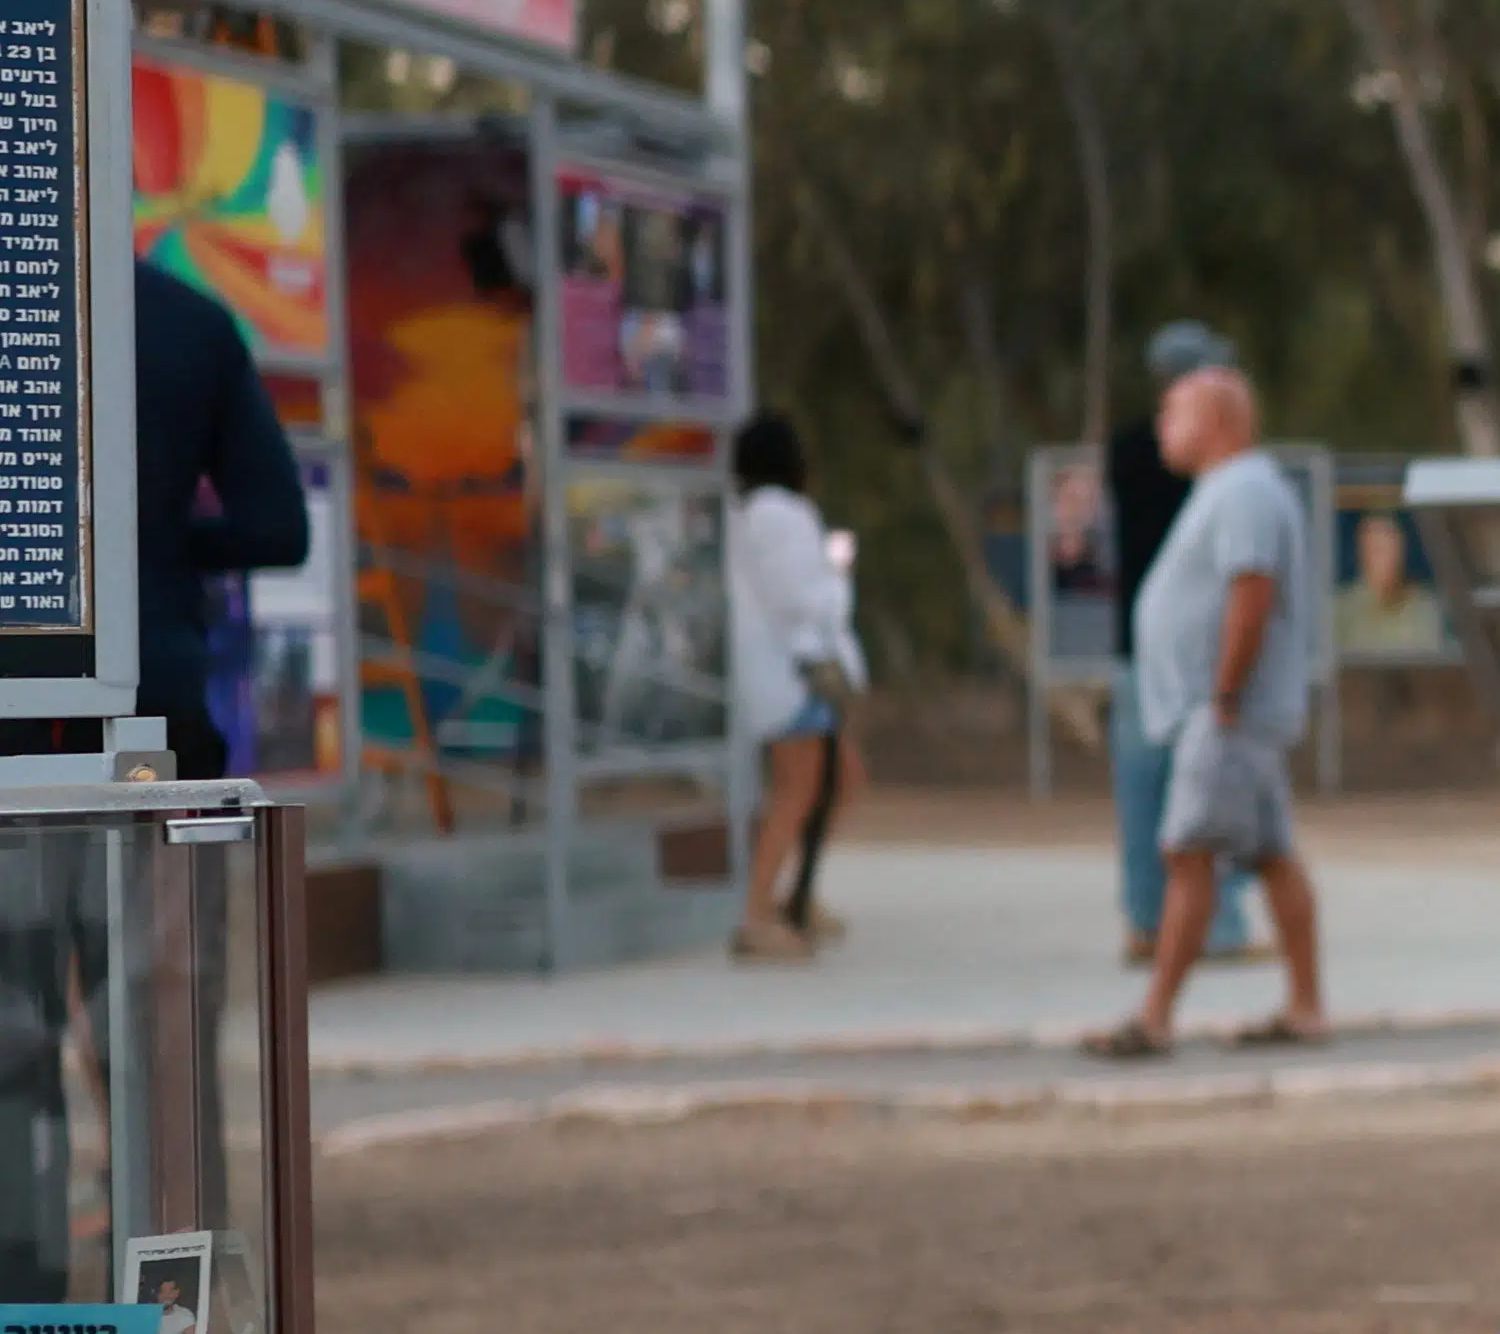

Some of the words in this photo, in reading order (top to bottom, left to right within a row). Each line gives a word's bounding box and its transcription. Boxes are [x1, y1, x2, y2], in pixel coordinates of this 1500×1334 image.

[12, 21, 55, 35] ליאב
[8, 46, 31, 58] 23
[37, 47, 56, 62] בן
[1, 69, 56, 83] ברעים
[21, 91, 56, 107] בעל
[19, 118, 56, 133] חיוך
[14, 140, 57, 155] ליאב
[14, 165, 57, 179] אהוב
[15, 187, 58, 203] ליאב
[19, 213, 58, 227] צנוע
[1, 235, 58, 250] תלמיד
[16, 259, 59, 274] לוחם
[16, 283, 59, 298] ליאב
[16, 309, 59, 322] אוהב
[1, 333, 60, 348] התאמן
[18, 355, 60, 370] לוחם
[24, 381, 60, 394] אהב
[27, 405, 61, 420] דרך
[17, 429, 61, 441] אוהד
[23, 453, 61, 465] אייס
[17, 501, 62, 513] דמות
[25, 548, 63, 561] אתה
[21, 569, 63, 584] ליאב
[21, 596, 64, 608] האור
